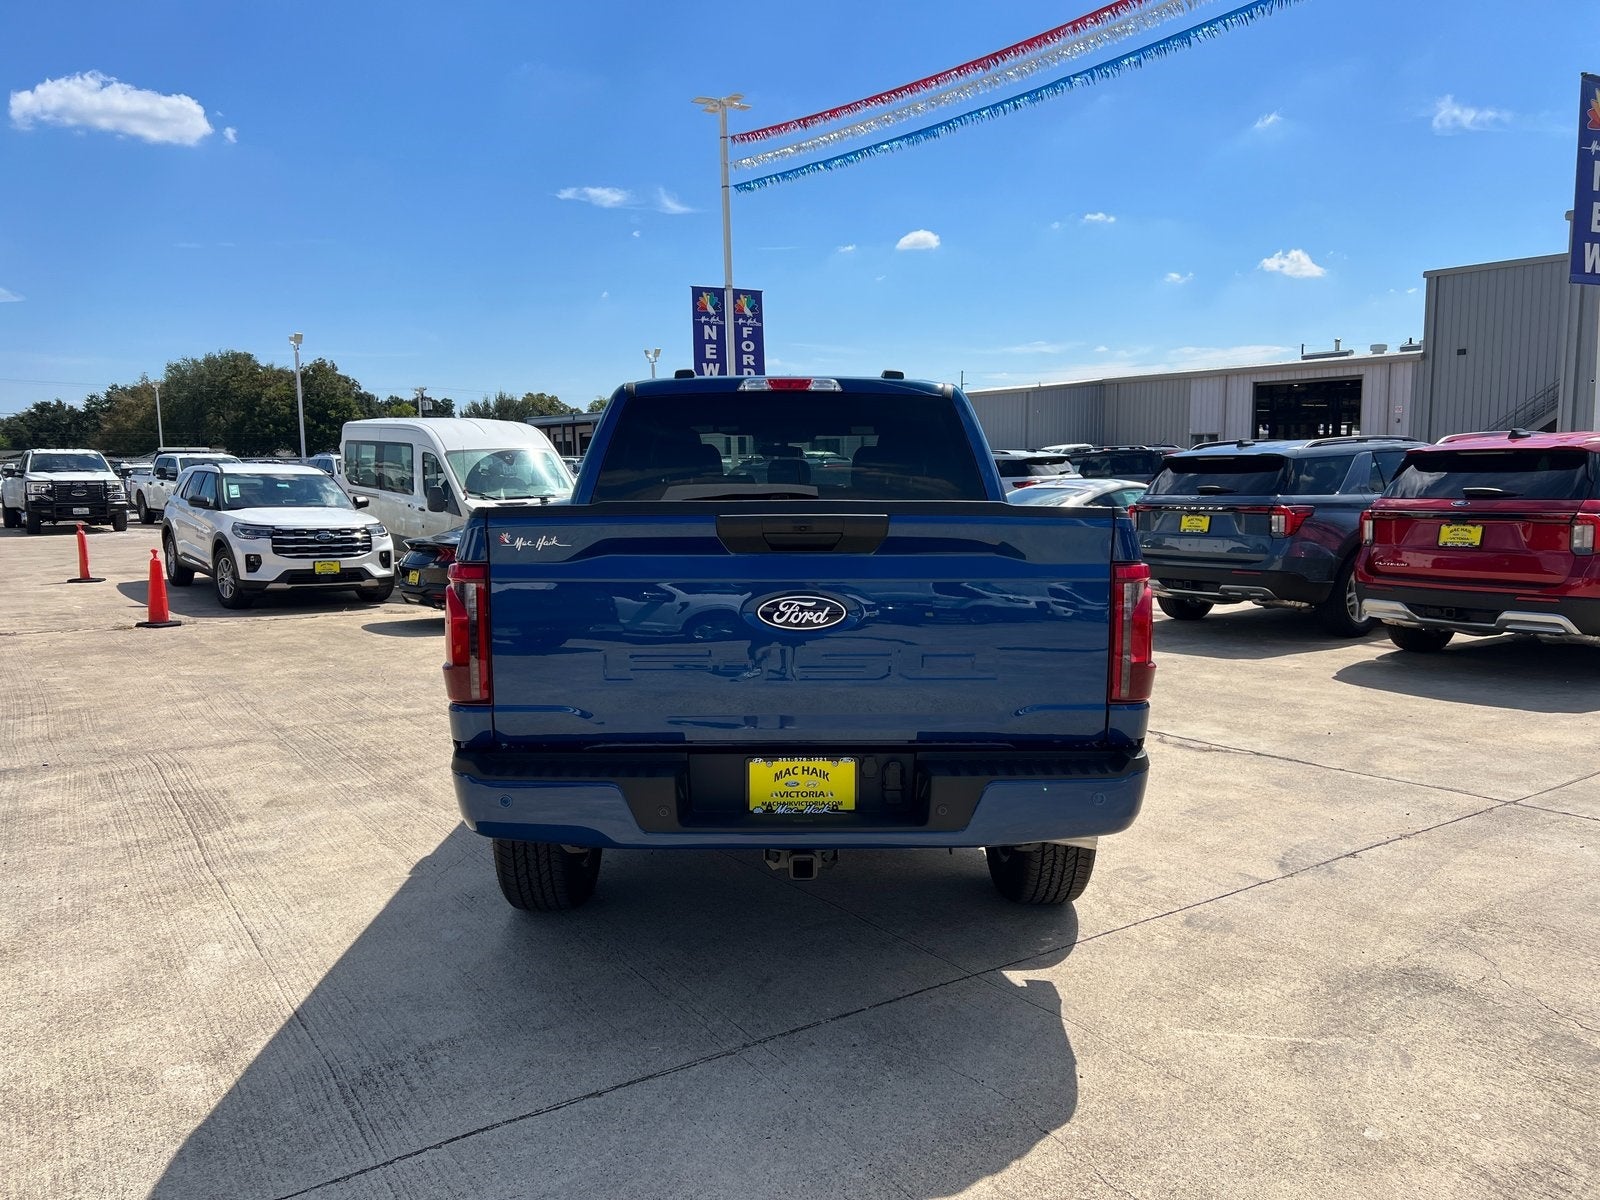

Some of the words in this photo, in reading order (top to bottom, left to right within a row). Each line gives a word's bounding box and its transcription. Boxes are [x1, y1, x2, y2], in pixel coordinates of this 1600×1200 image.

[702, 325, 720, 376] NEW
[741, 327, 756, 376] FORD
[508, 536, 535, 551] Mac
[535, 535, 563, 551] Haik
[773, 596, 831, 625] Ford
[774, 766, 799, 782] MAC
[801, 766, 830, 782] HAIK
[778, 790, 826, 798] VICTORIA
[774, 804, 802, 815] Mac
[803, 804, 836, 815] Haik
